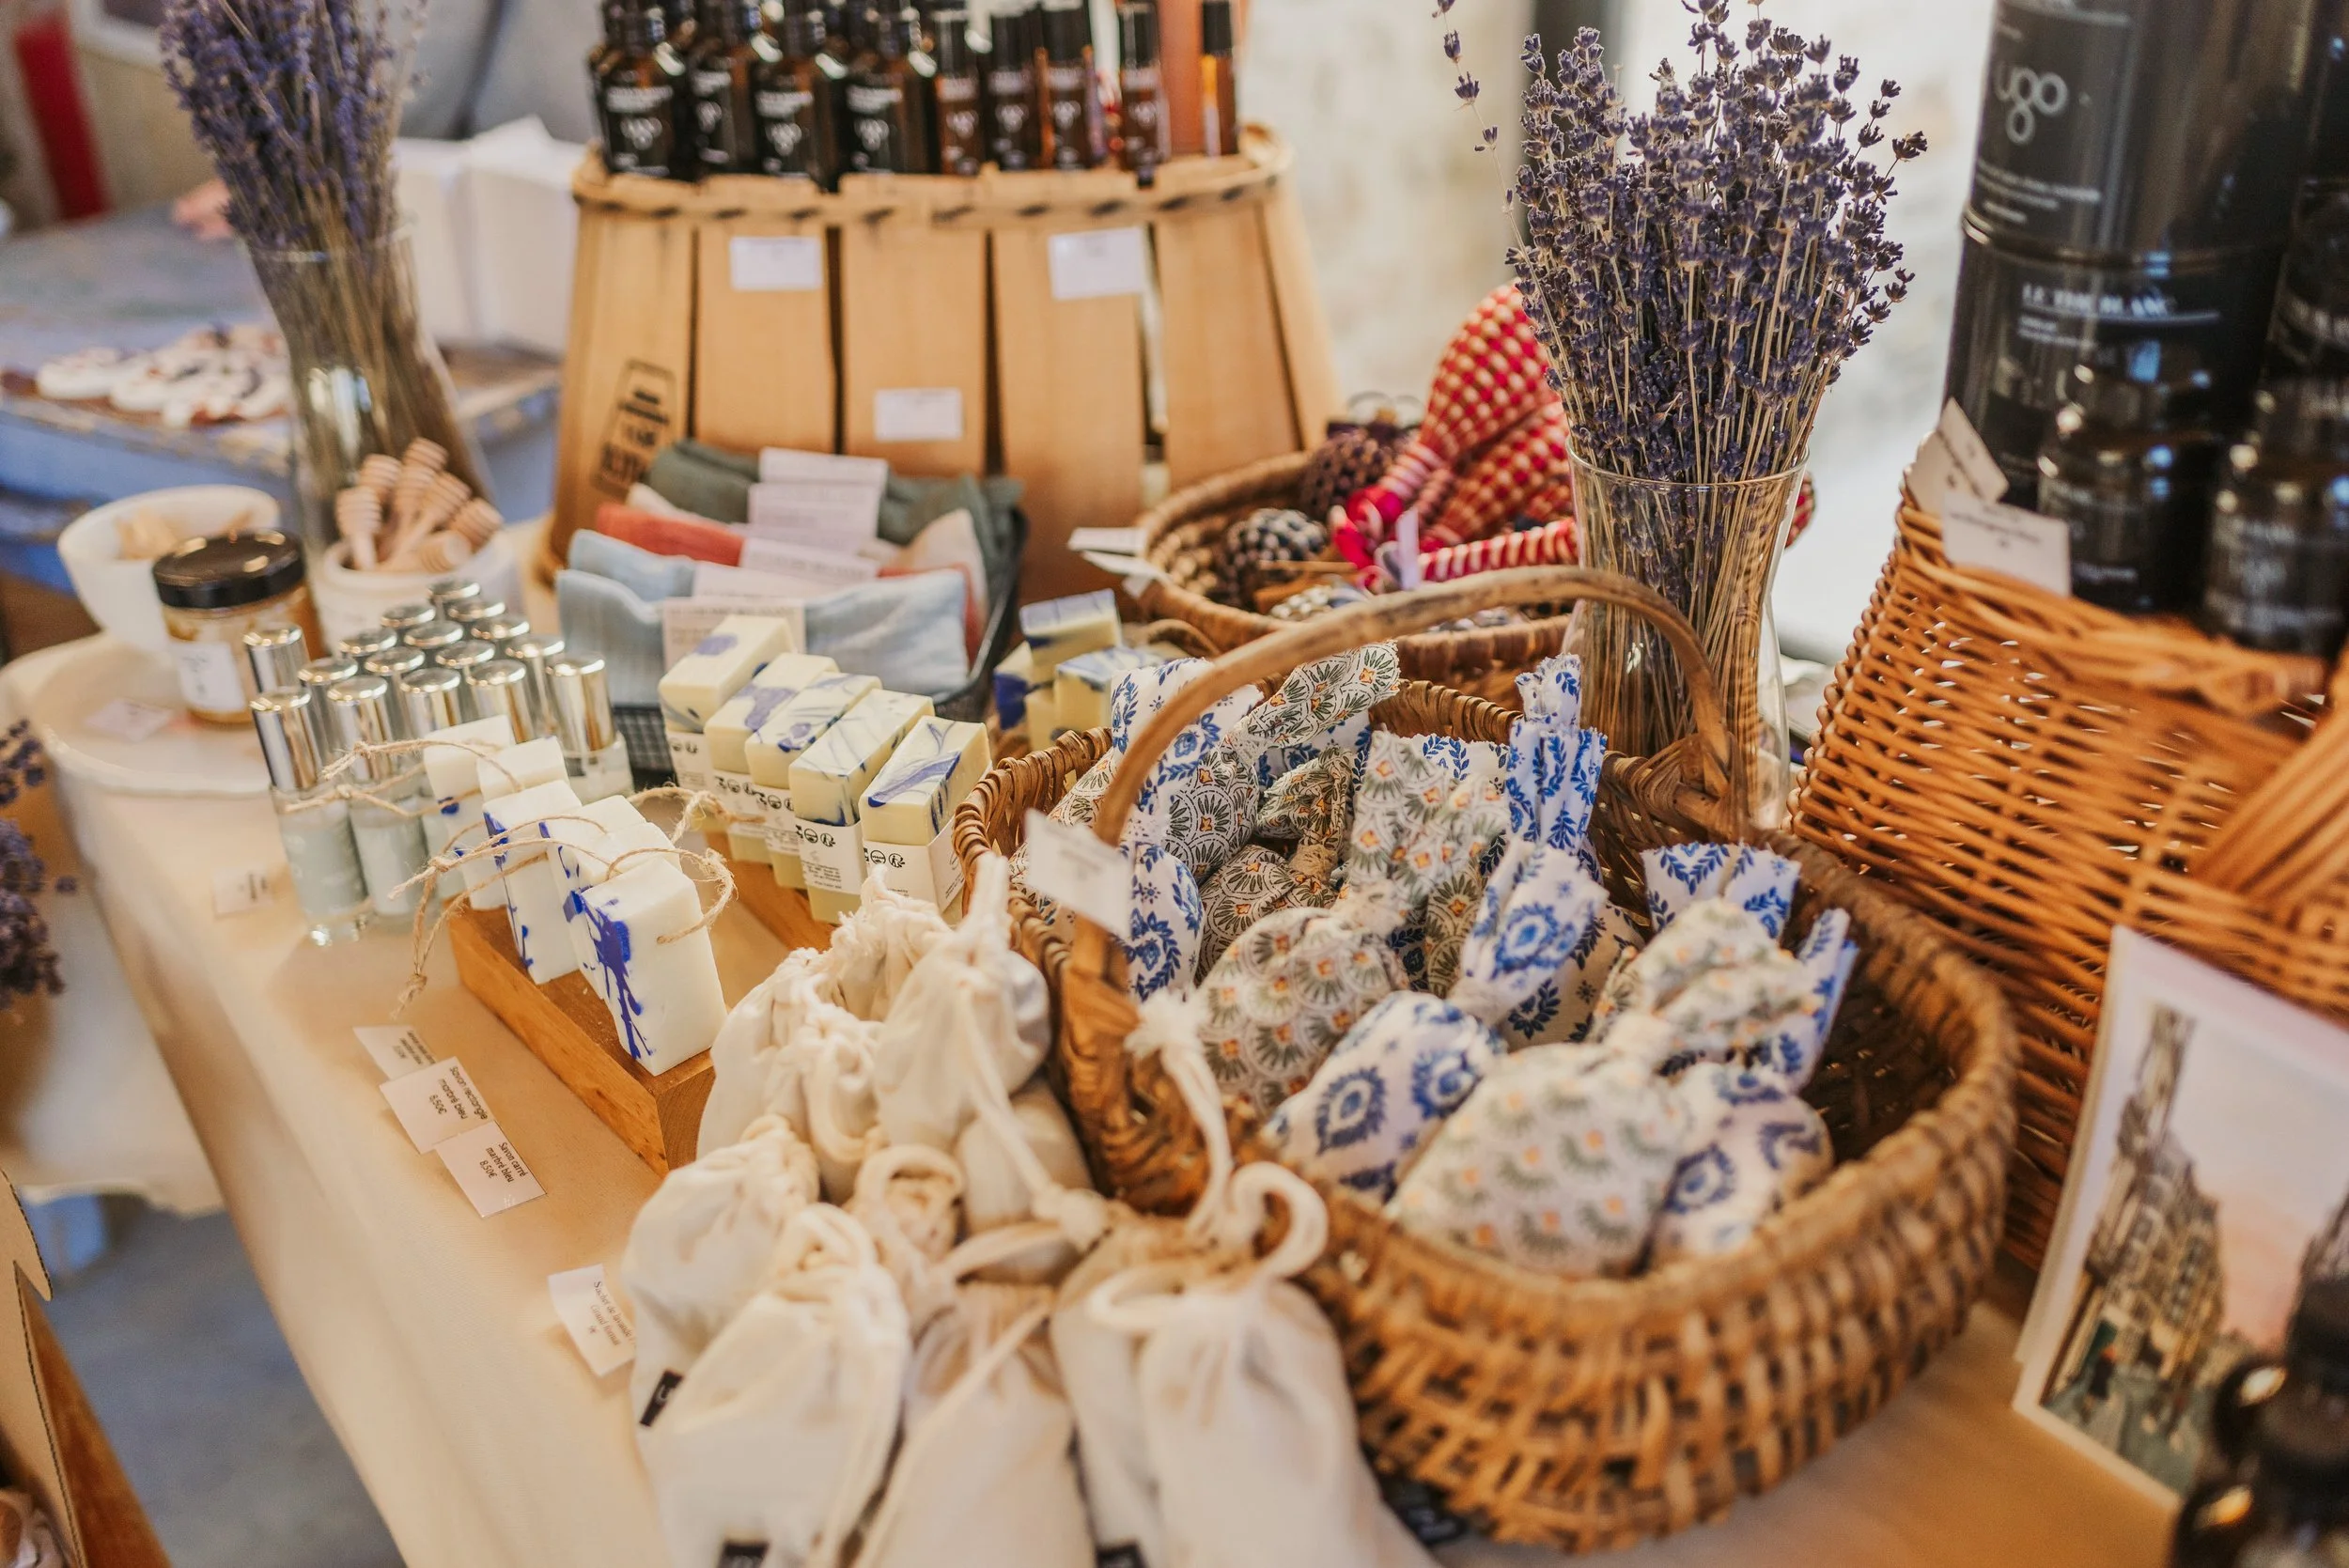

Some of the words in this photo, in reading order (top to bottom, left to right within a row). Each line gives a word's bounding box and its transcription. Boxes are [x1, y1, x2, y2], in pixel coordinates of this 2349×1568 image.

[449, 1065, 467, 1087] Savon
[464, 1086, 488, 1120] rectangle
[454, 1102, 468, 1120] bleu
[479, 1160, 497, 1178] 8,50€
[486, 1147, 505, 1169] marbré
[501, 1167, 515, 1183] bleu
[498, 1141, 515, 1161] Savon
[511, 1159, 528, 1177] carré
